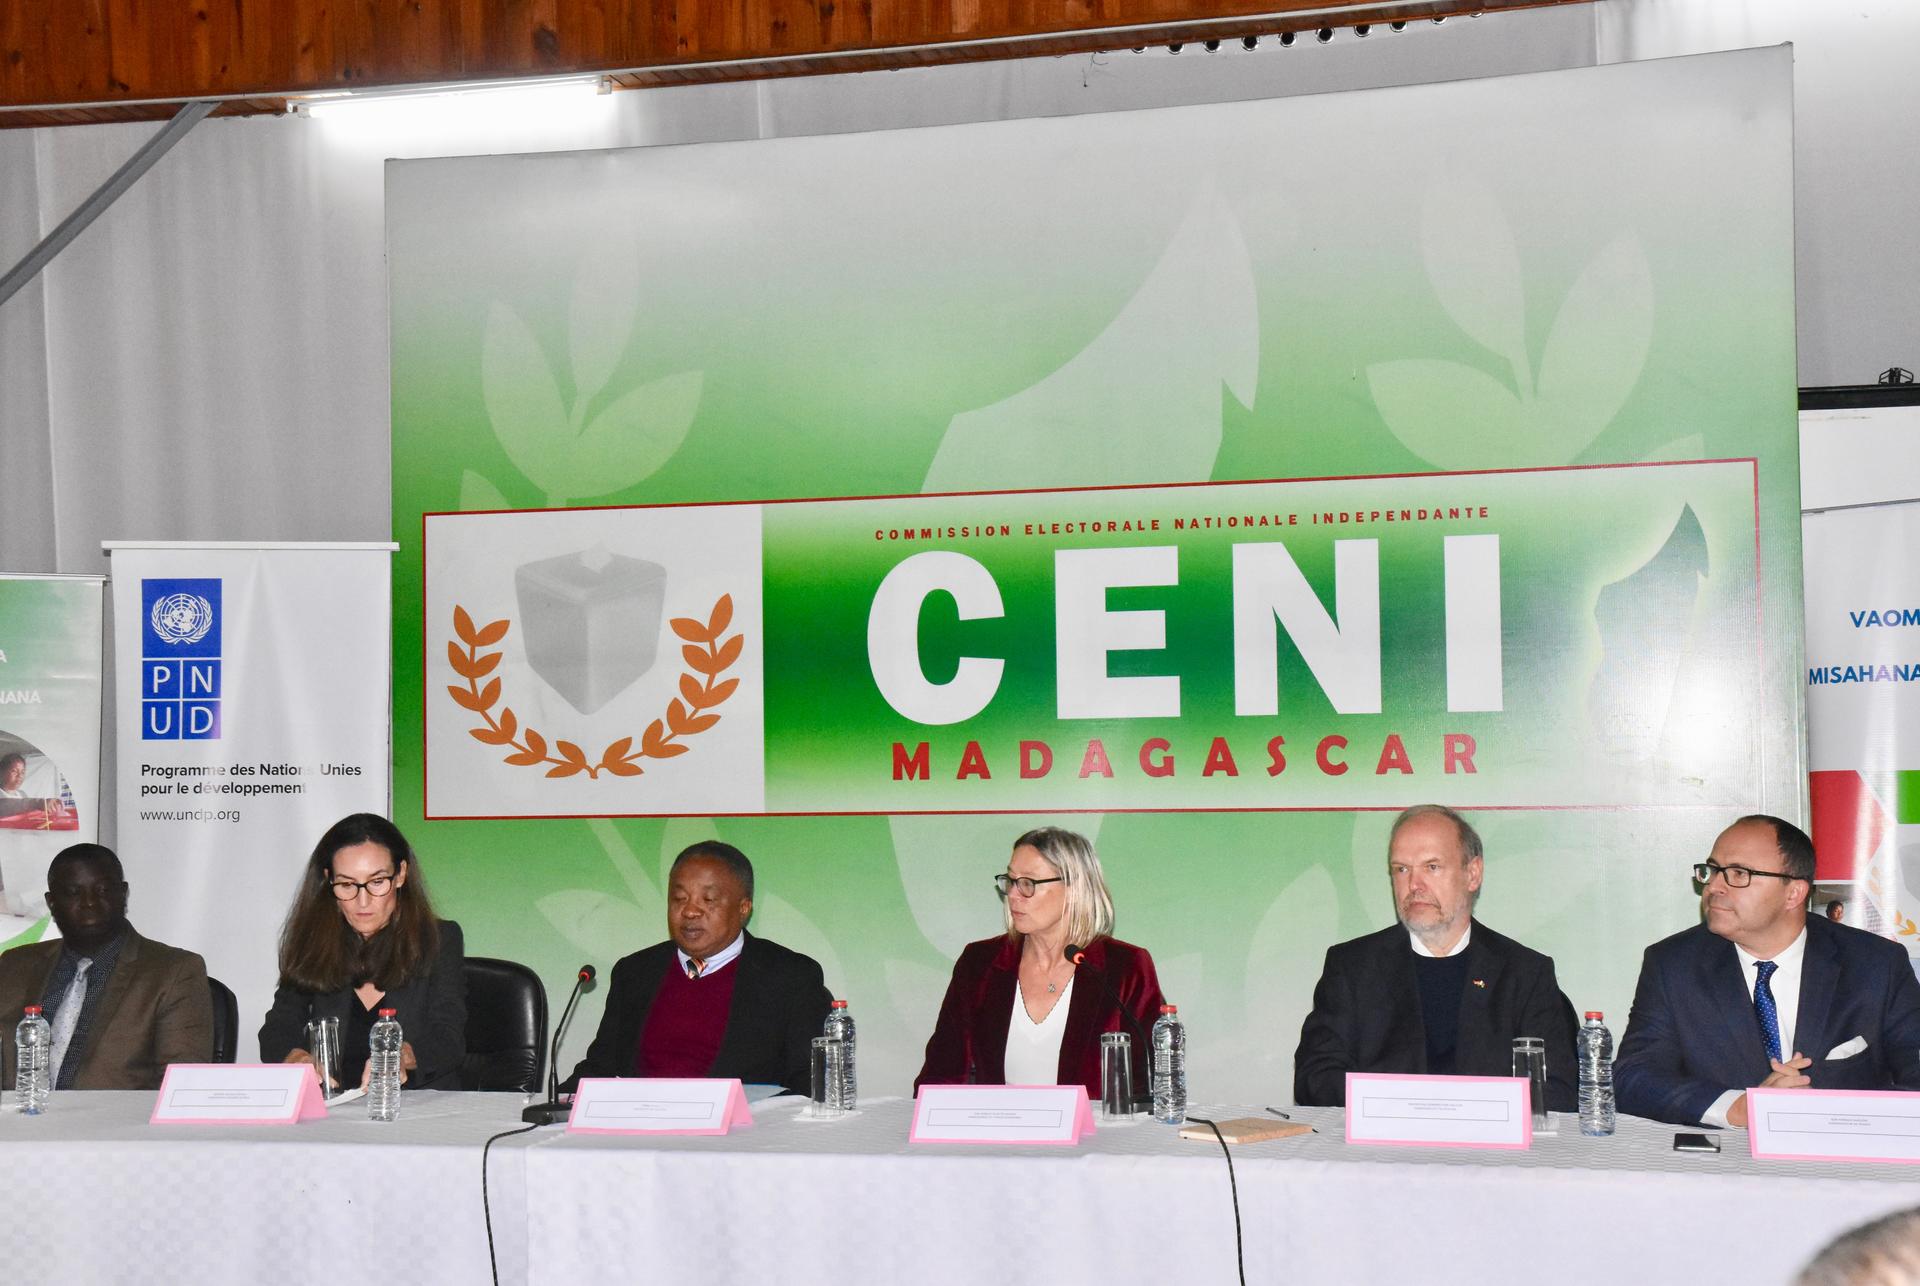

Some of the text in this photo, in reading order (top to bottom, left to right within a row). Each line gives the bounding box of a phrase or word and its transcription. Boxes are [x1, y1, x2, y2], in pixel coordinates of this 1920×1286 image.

[875, 506, 1489, 541] COMMISSION ELECTORALE NATIONALE INDEPENDANTE
[1849, 608, 1920, 628] VAOM
[867, 534, 1503, 726] CENI
[1809, 664, 1920, 685] MISAHANA
[892, 733, 1478, 781] MADAGASCAR
[141, 764, 226, 779] Programme
[230, 763, 255, 776] des
[320, 763, 362, 776] Unies
[141, 782, 306, 797] pour le développement
[140, 809, 240, 823] www.undp.org
